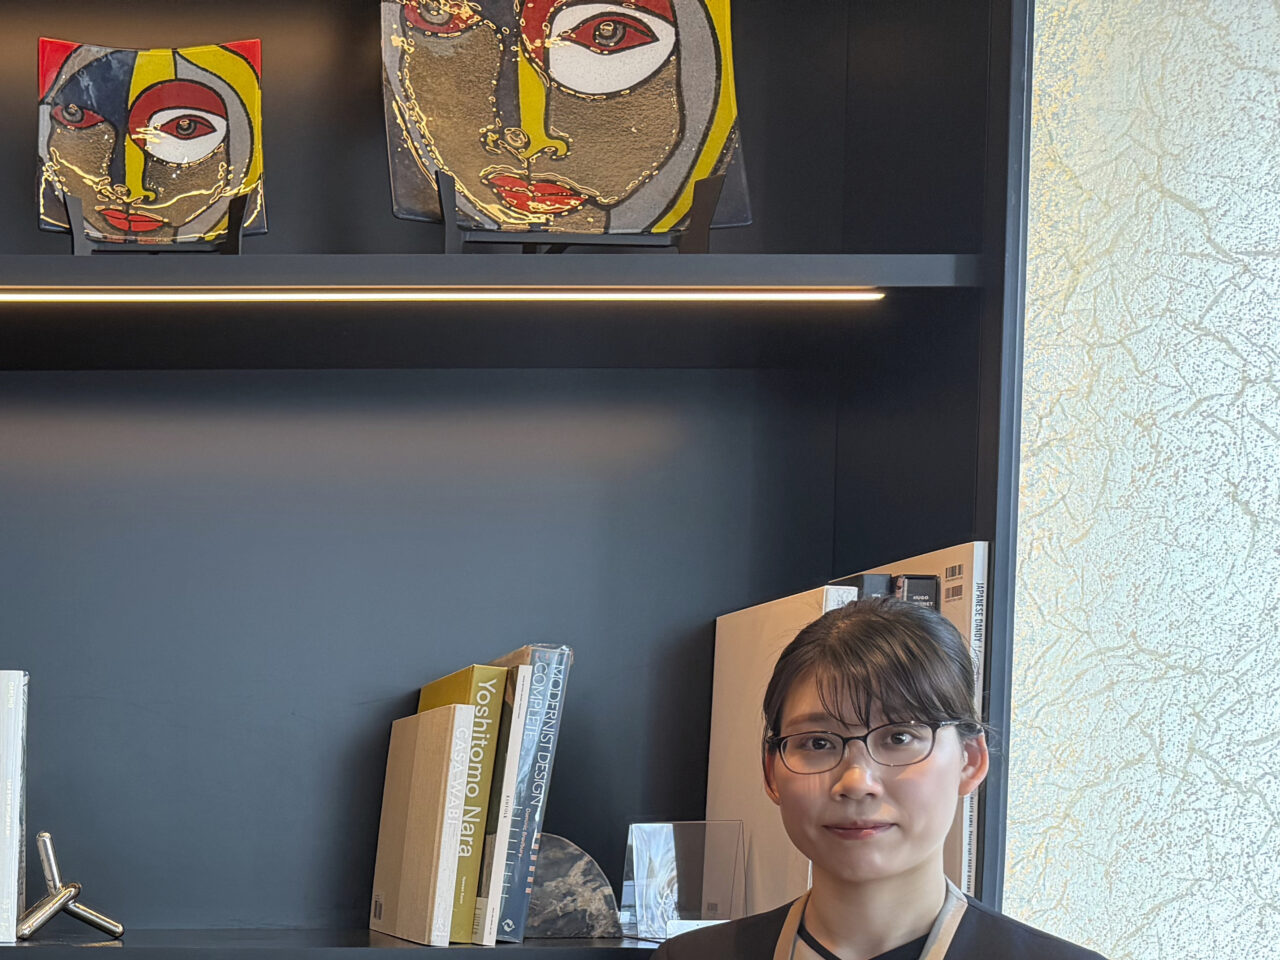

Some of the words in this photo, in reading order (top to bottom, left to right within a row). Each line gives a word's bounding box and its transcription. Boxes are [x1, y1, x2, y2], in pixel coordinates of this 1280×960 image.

[974, 582, 985, 617] JAPANESE
[973, 619, 984, 643] DANDY
[541, 664, 564, 750] MODERNIST
[452, 727, 469, 770] CASA
[464, 678, 497, 799] Yoshitomo
[447, 776, 465, 824] WABI
[530, 753, 551, 806] DESIGN
[458, 806, 482, 858] Nara
